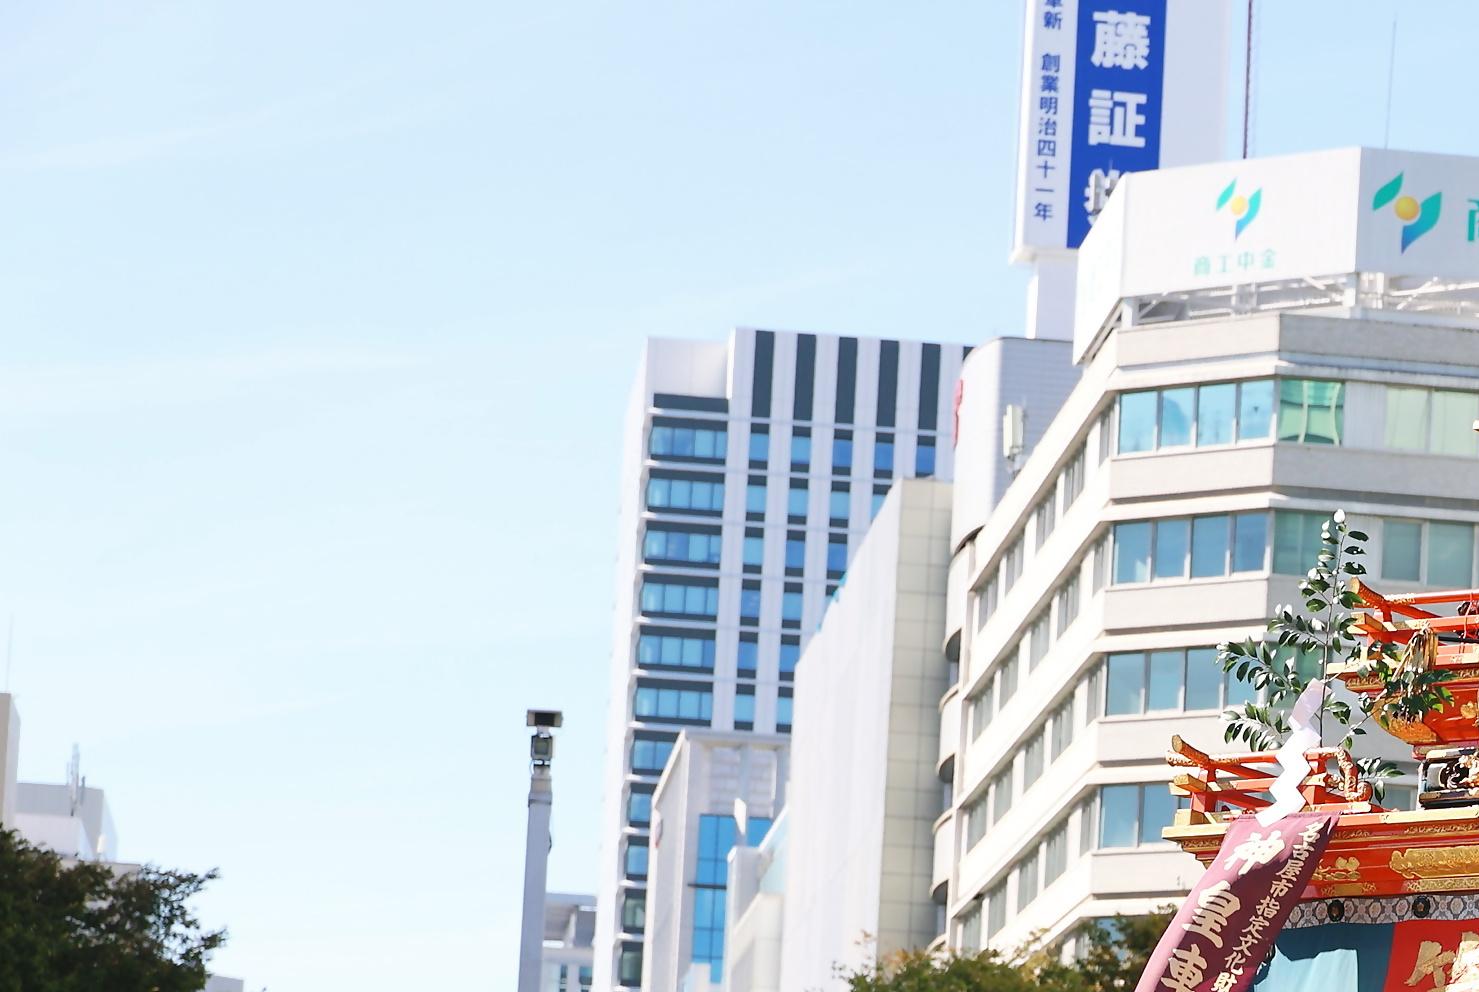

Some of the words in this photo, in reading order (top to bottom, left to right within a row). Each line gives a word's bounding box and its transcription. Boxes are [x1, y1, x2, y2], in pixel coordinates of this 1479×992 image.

[1034, 53, 1060, 221] 創業明治四十一年
[1193, 247, 1276, 277] 商工中金
